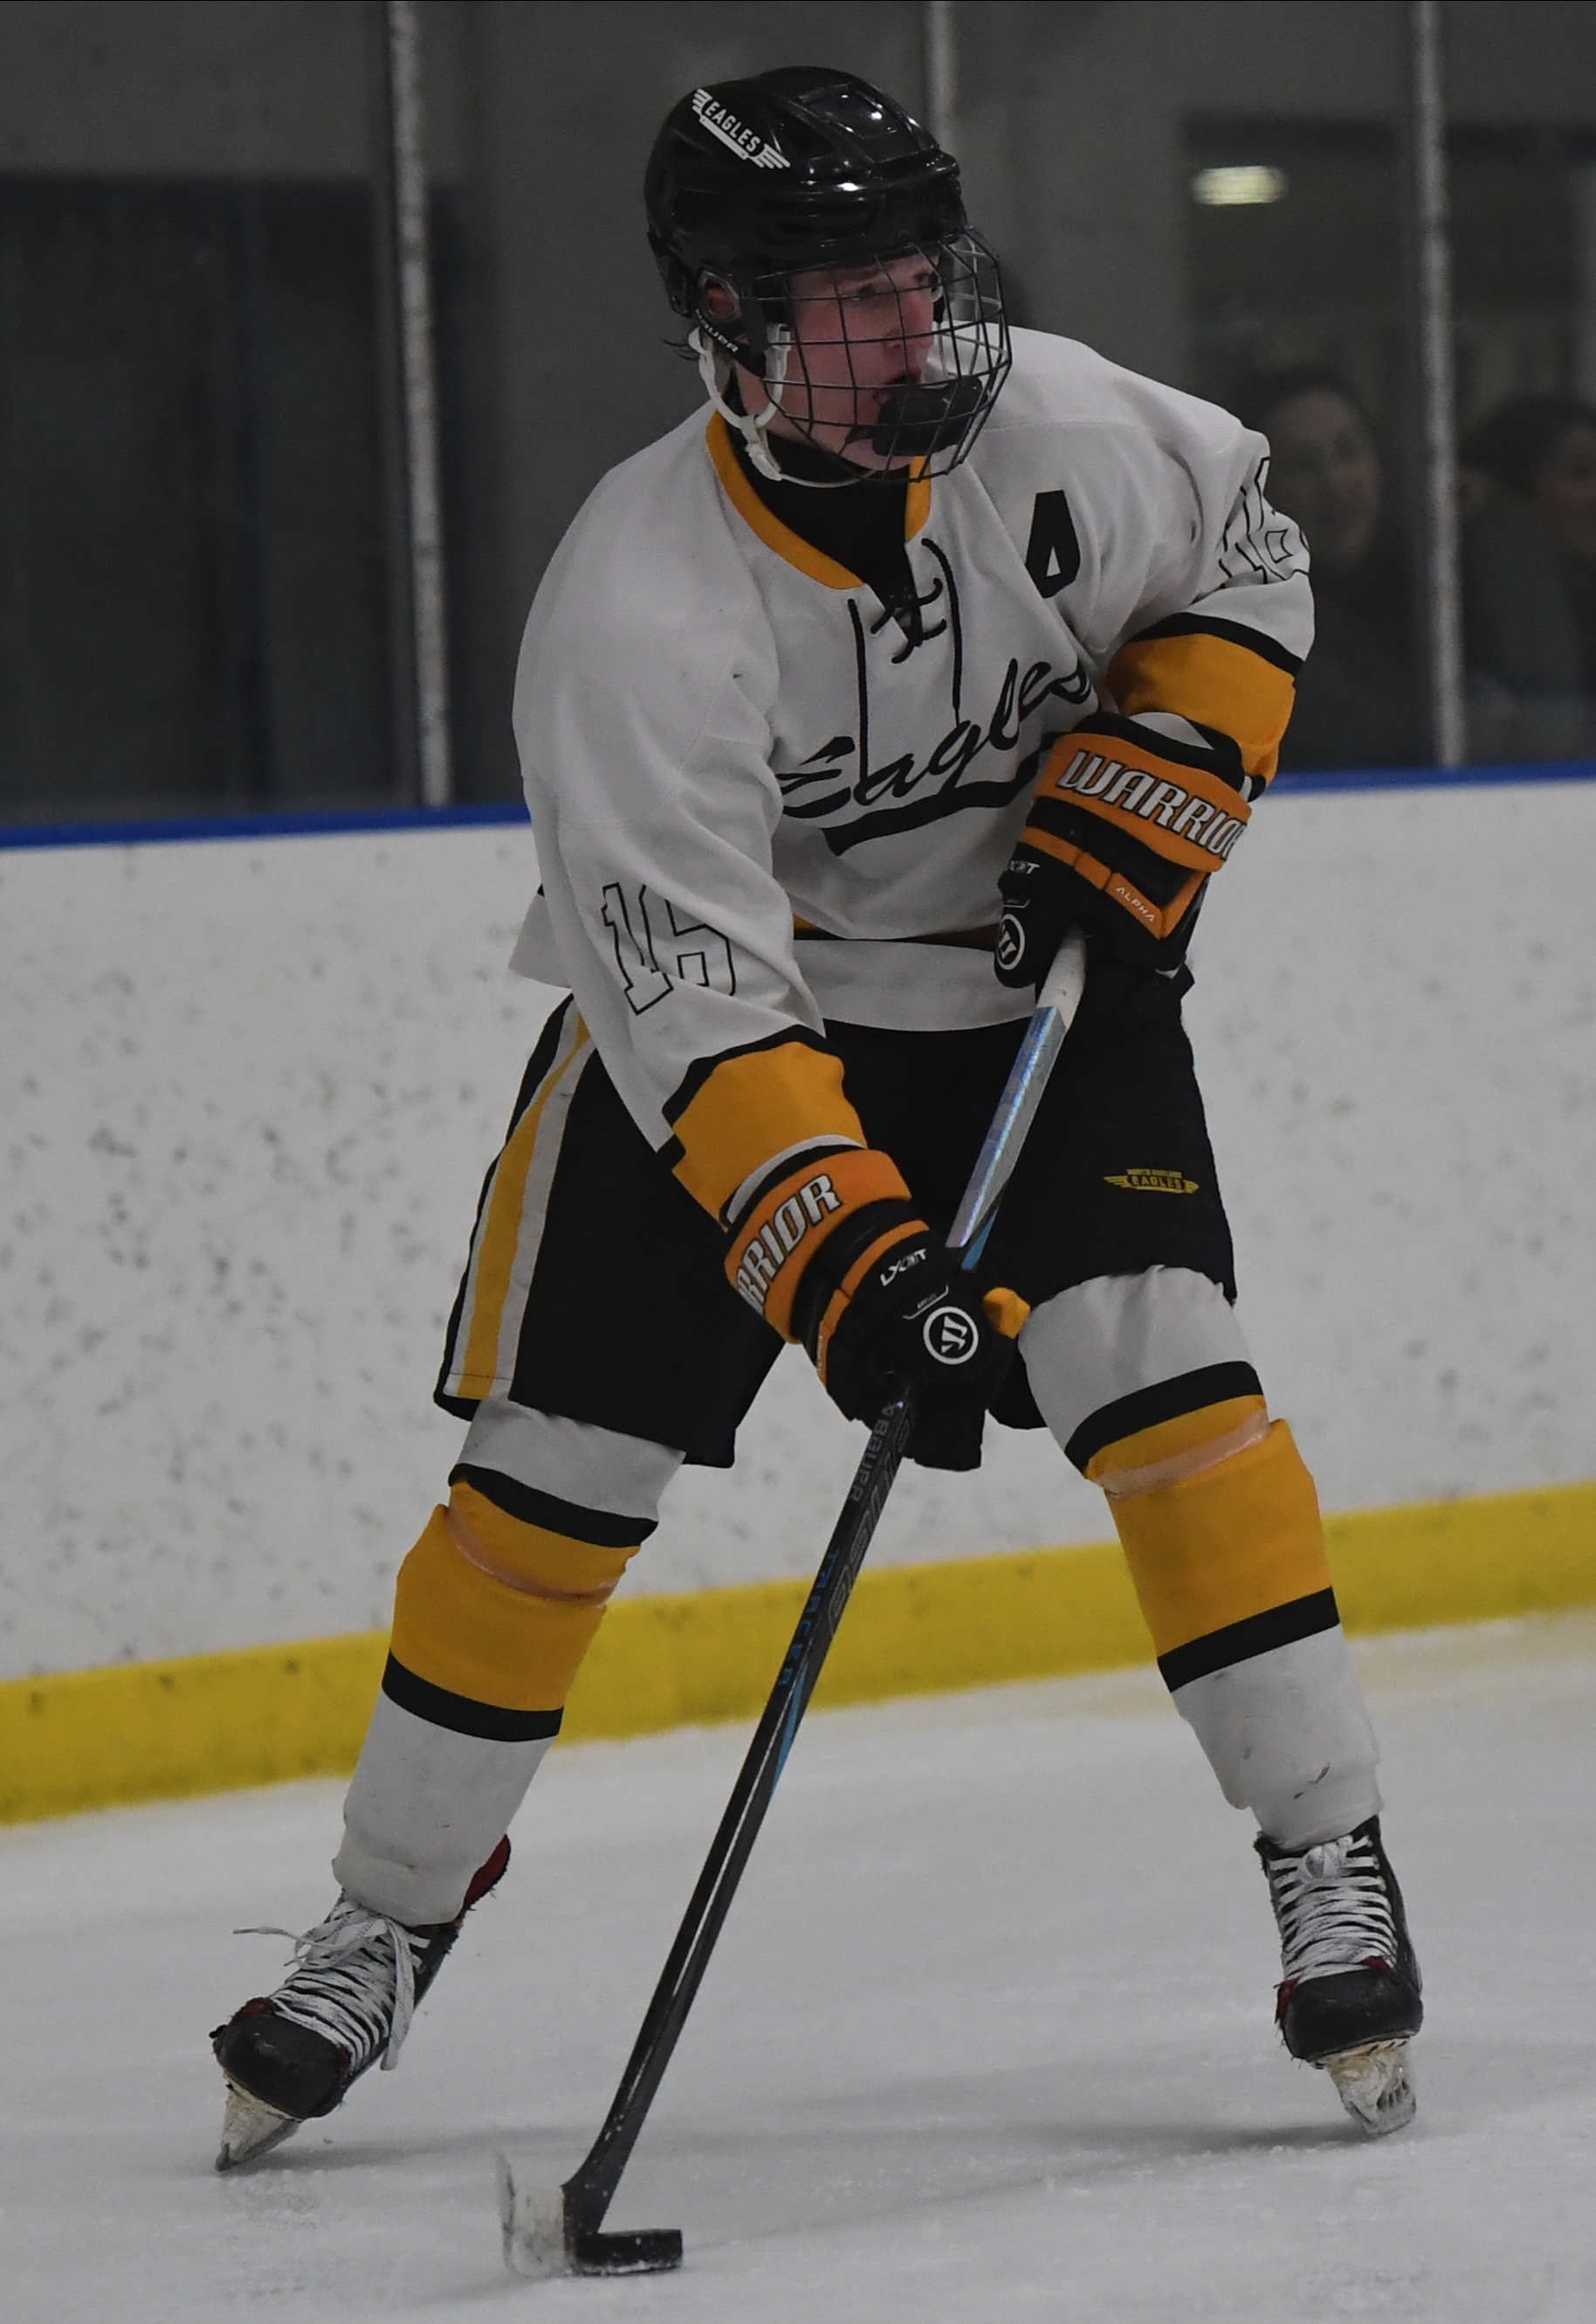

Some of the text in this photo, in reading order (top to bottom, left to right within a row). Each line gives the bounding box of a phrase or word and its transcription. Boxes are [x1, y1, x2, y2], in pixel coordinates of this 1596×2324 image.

[705, 101, 761, 153] EAGLES
[1025, 489, 1081, 598] A
[1115, 886, 1155, 922] ALPHA
